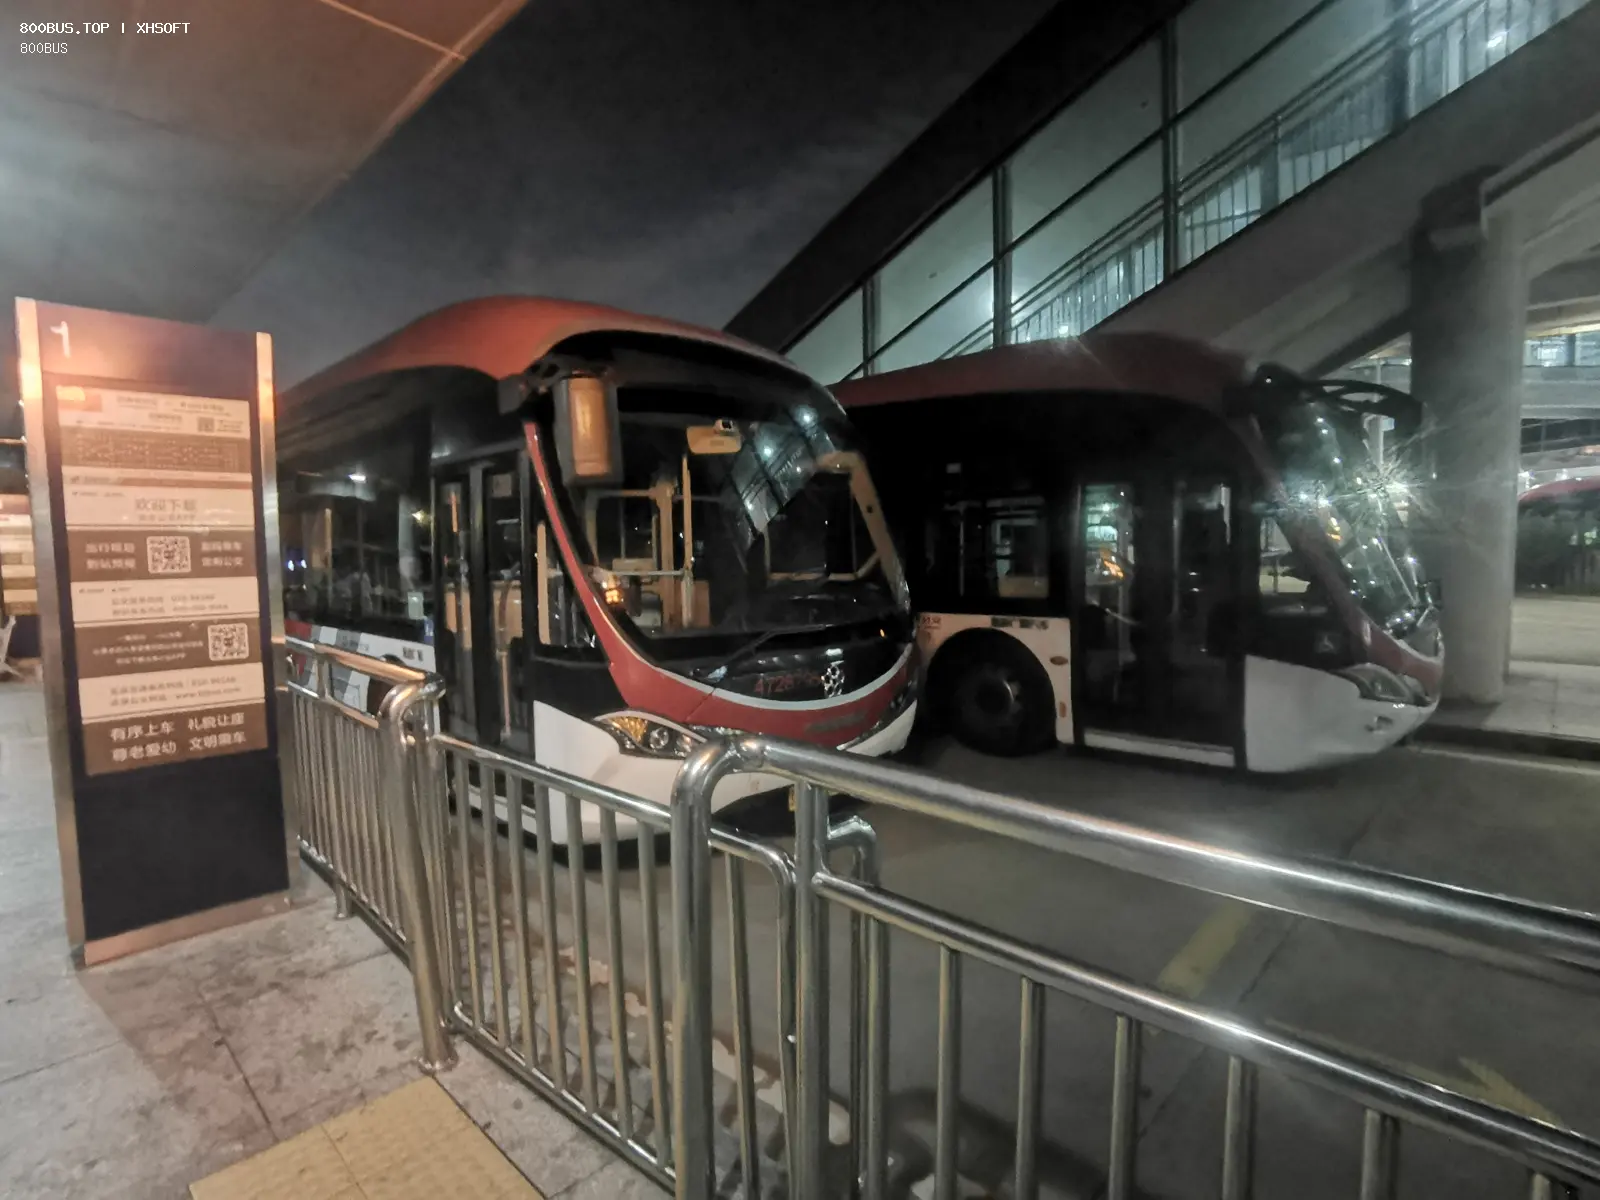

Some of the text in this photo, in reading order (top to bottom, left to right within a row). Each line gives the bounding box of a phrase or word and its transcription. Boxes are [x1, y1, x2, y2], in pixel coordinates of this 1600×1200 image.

[50, 321, 71, 359] 1
[110, 720, 175, 741] 有序上车
